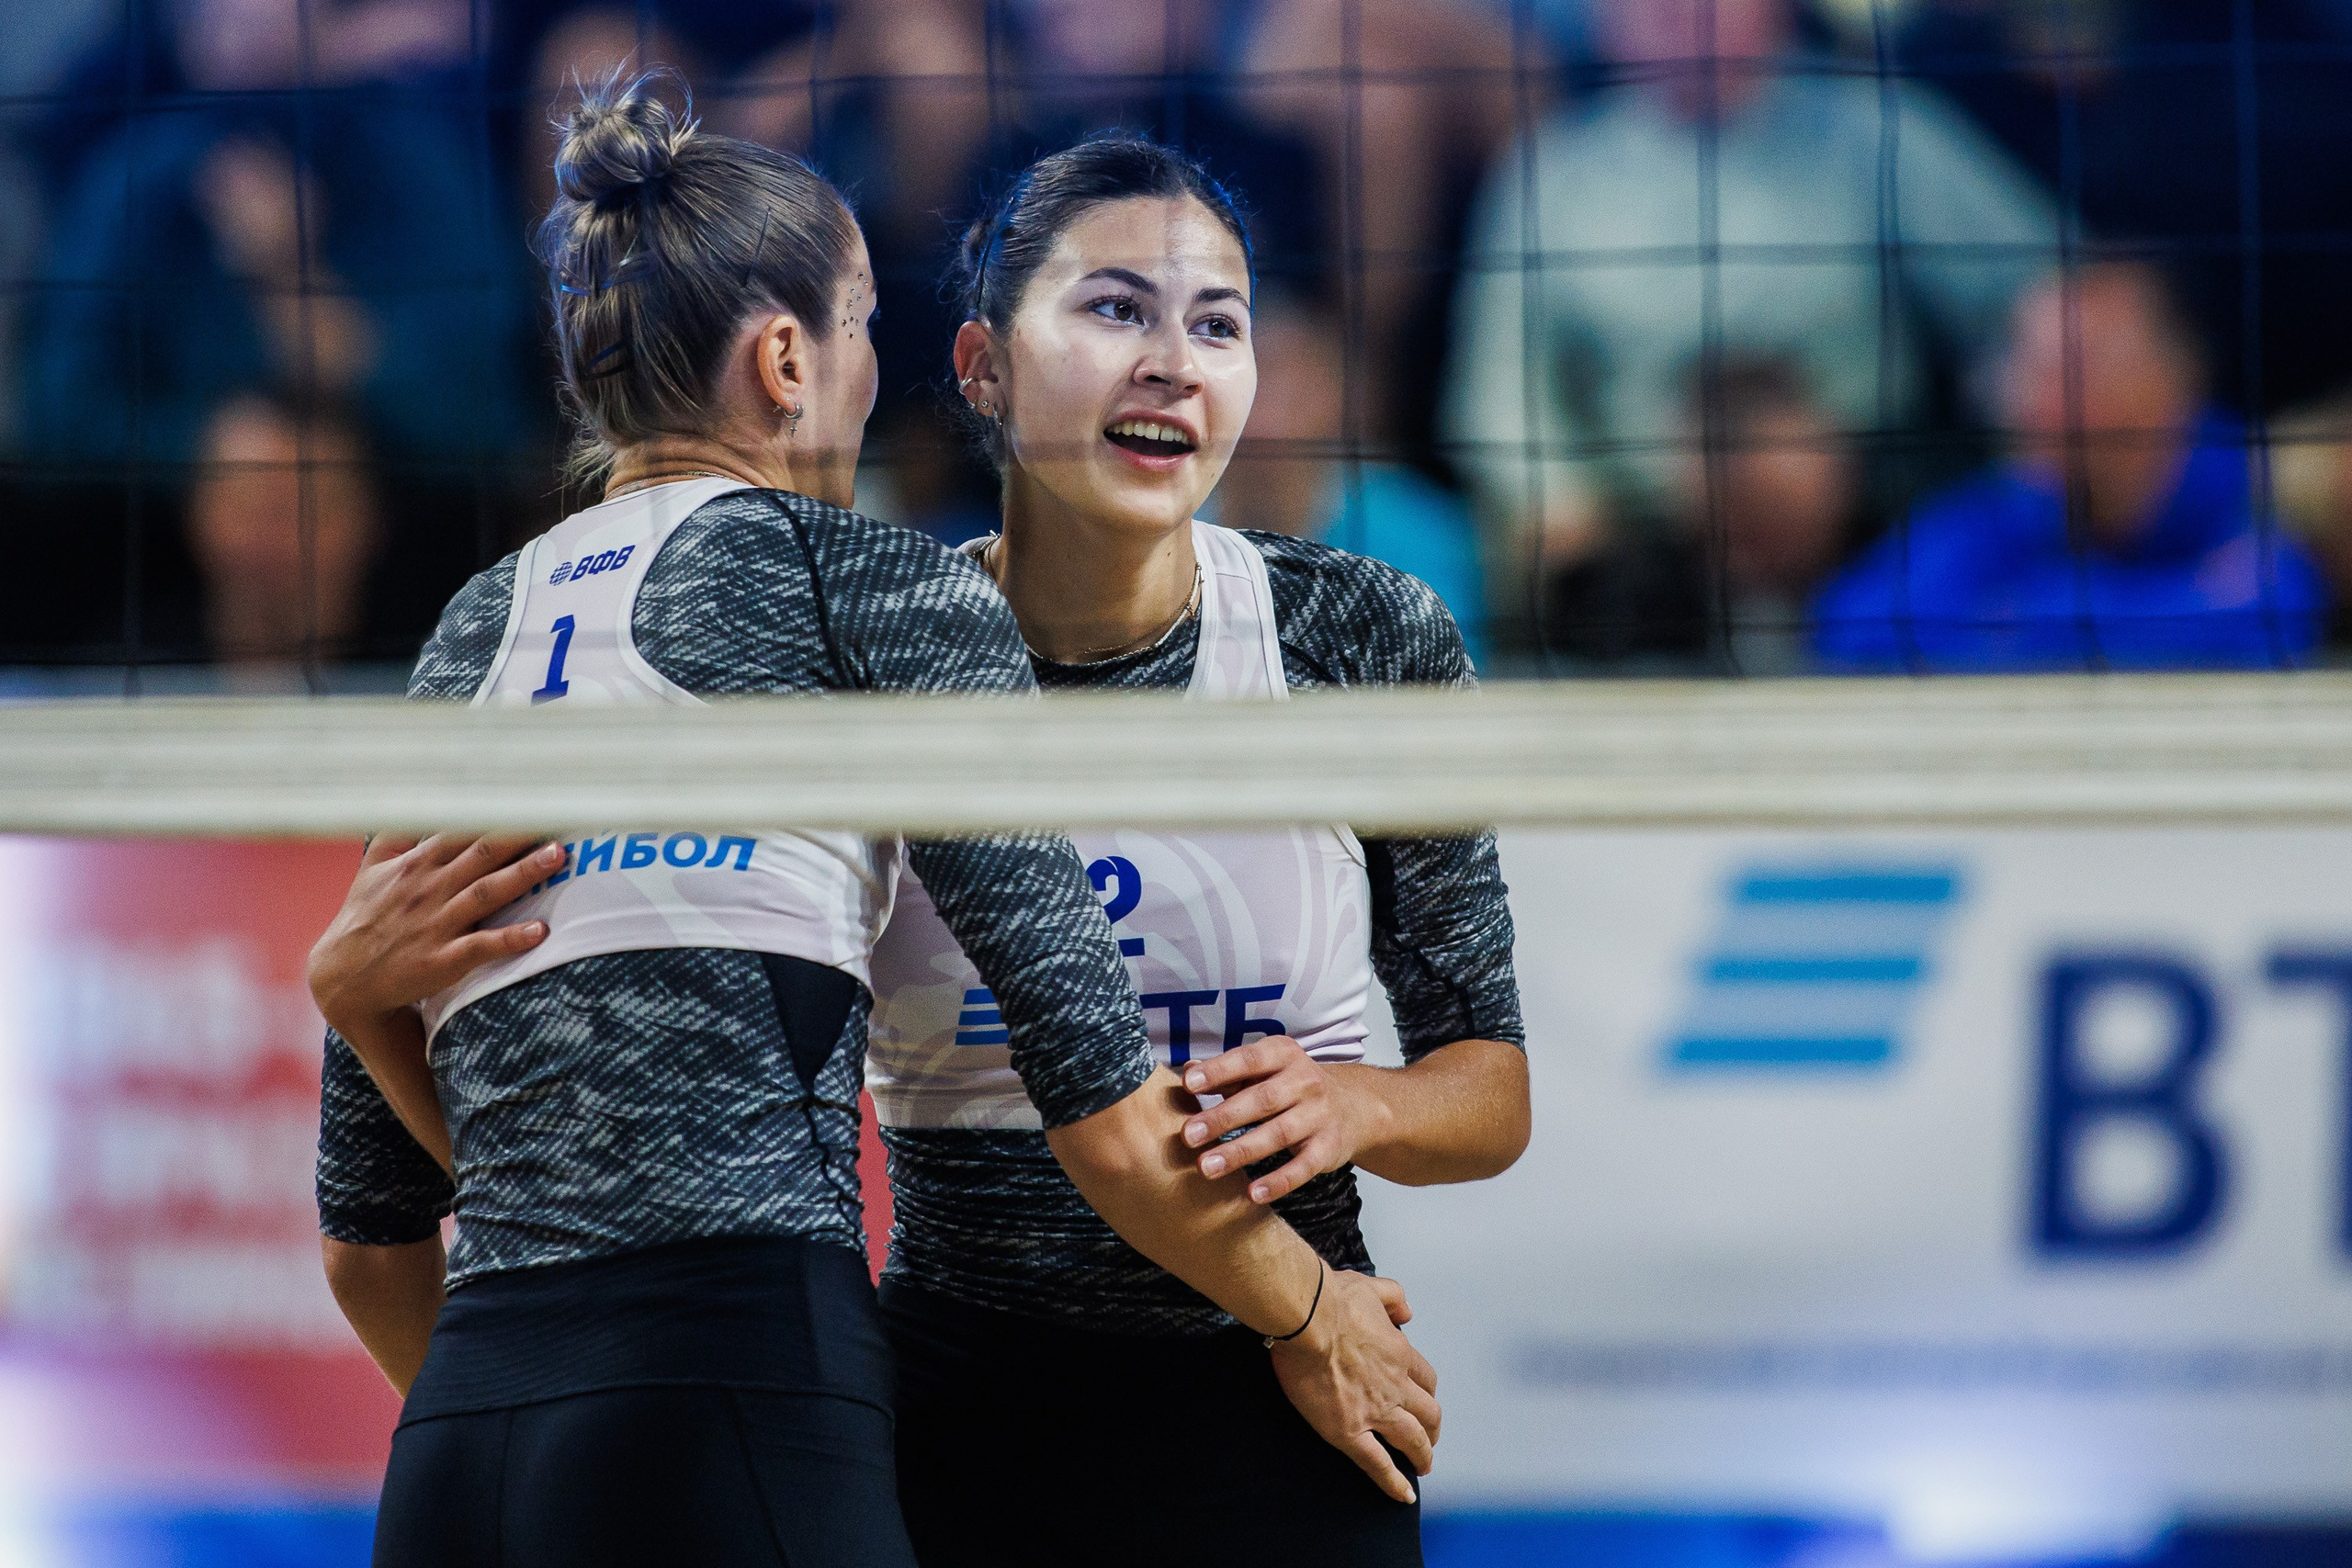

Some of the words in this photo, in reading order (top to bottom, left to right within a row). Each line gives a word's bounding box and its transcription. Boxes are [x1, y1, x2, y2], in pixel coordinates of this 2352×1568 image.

[569, 545, 636, 582] ВФВ
[530, 615, 575, 706] 1
[530, 829, 757, 894] ЙБОЛ
[1085, 855, 1145, 957] 2
[1139, 983, 1286, 1067] ТБ
[2029, 946, 2352, 1258] ВТ
